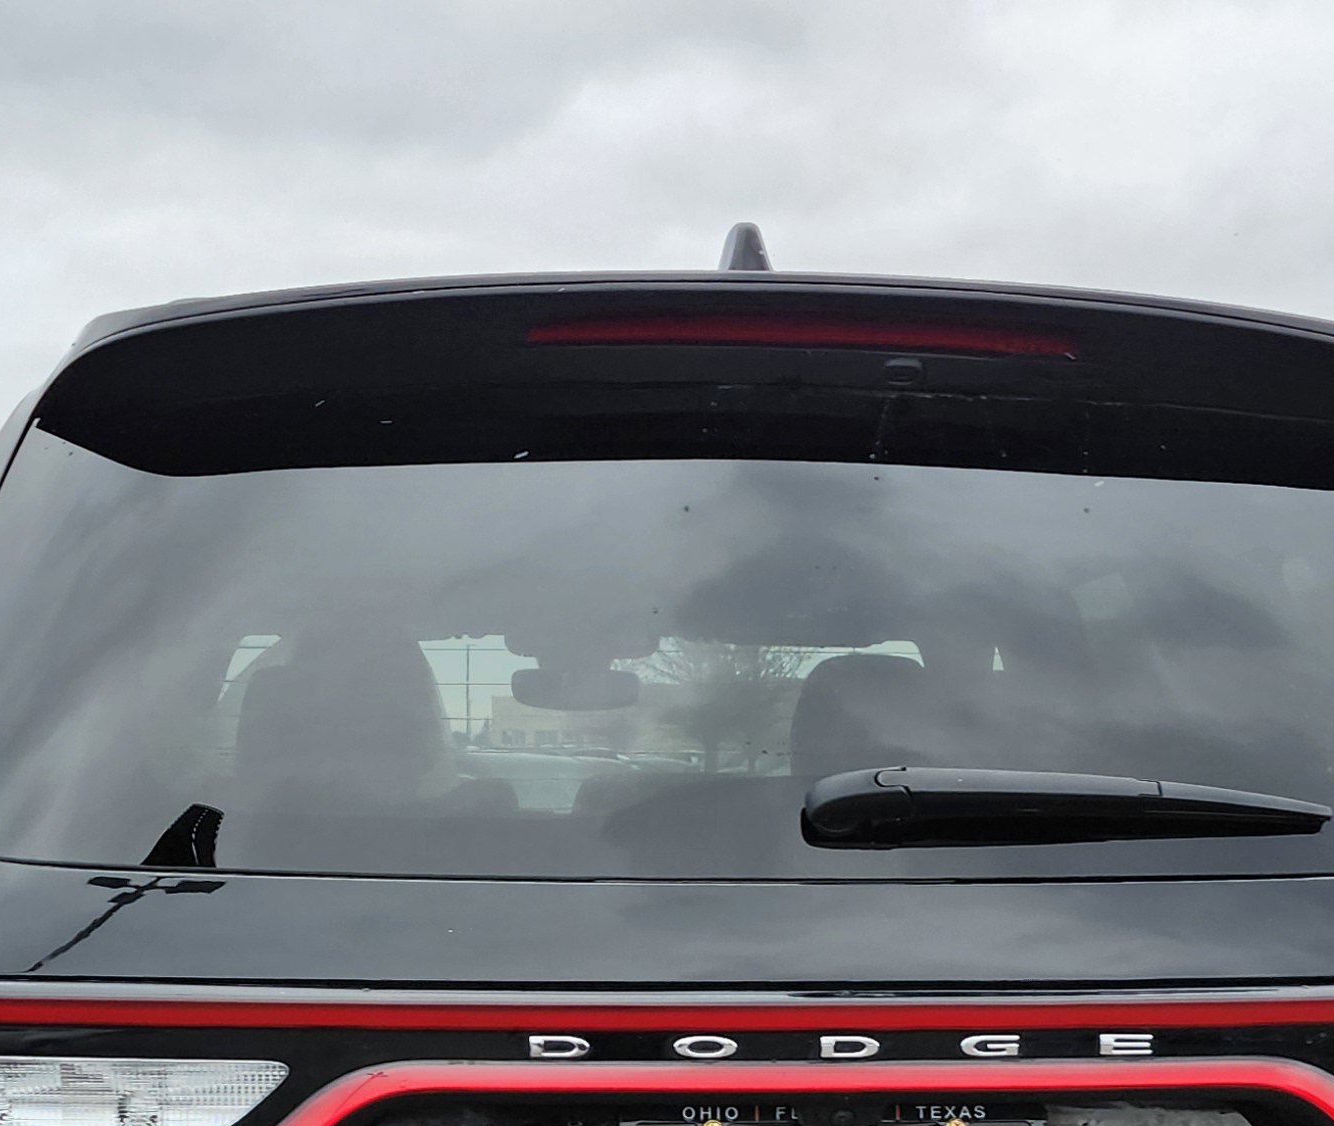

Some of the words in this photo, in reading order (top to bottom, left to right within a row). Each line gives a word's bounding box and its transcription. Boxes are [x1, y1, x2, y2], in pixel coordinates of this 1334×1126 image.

[528, 1033, 1154, 1059] DODGE
[682, 1106, 738, 1121] OHIO
[916, 1105, 986, 1120] TEXAS
